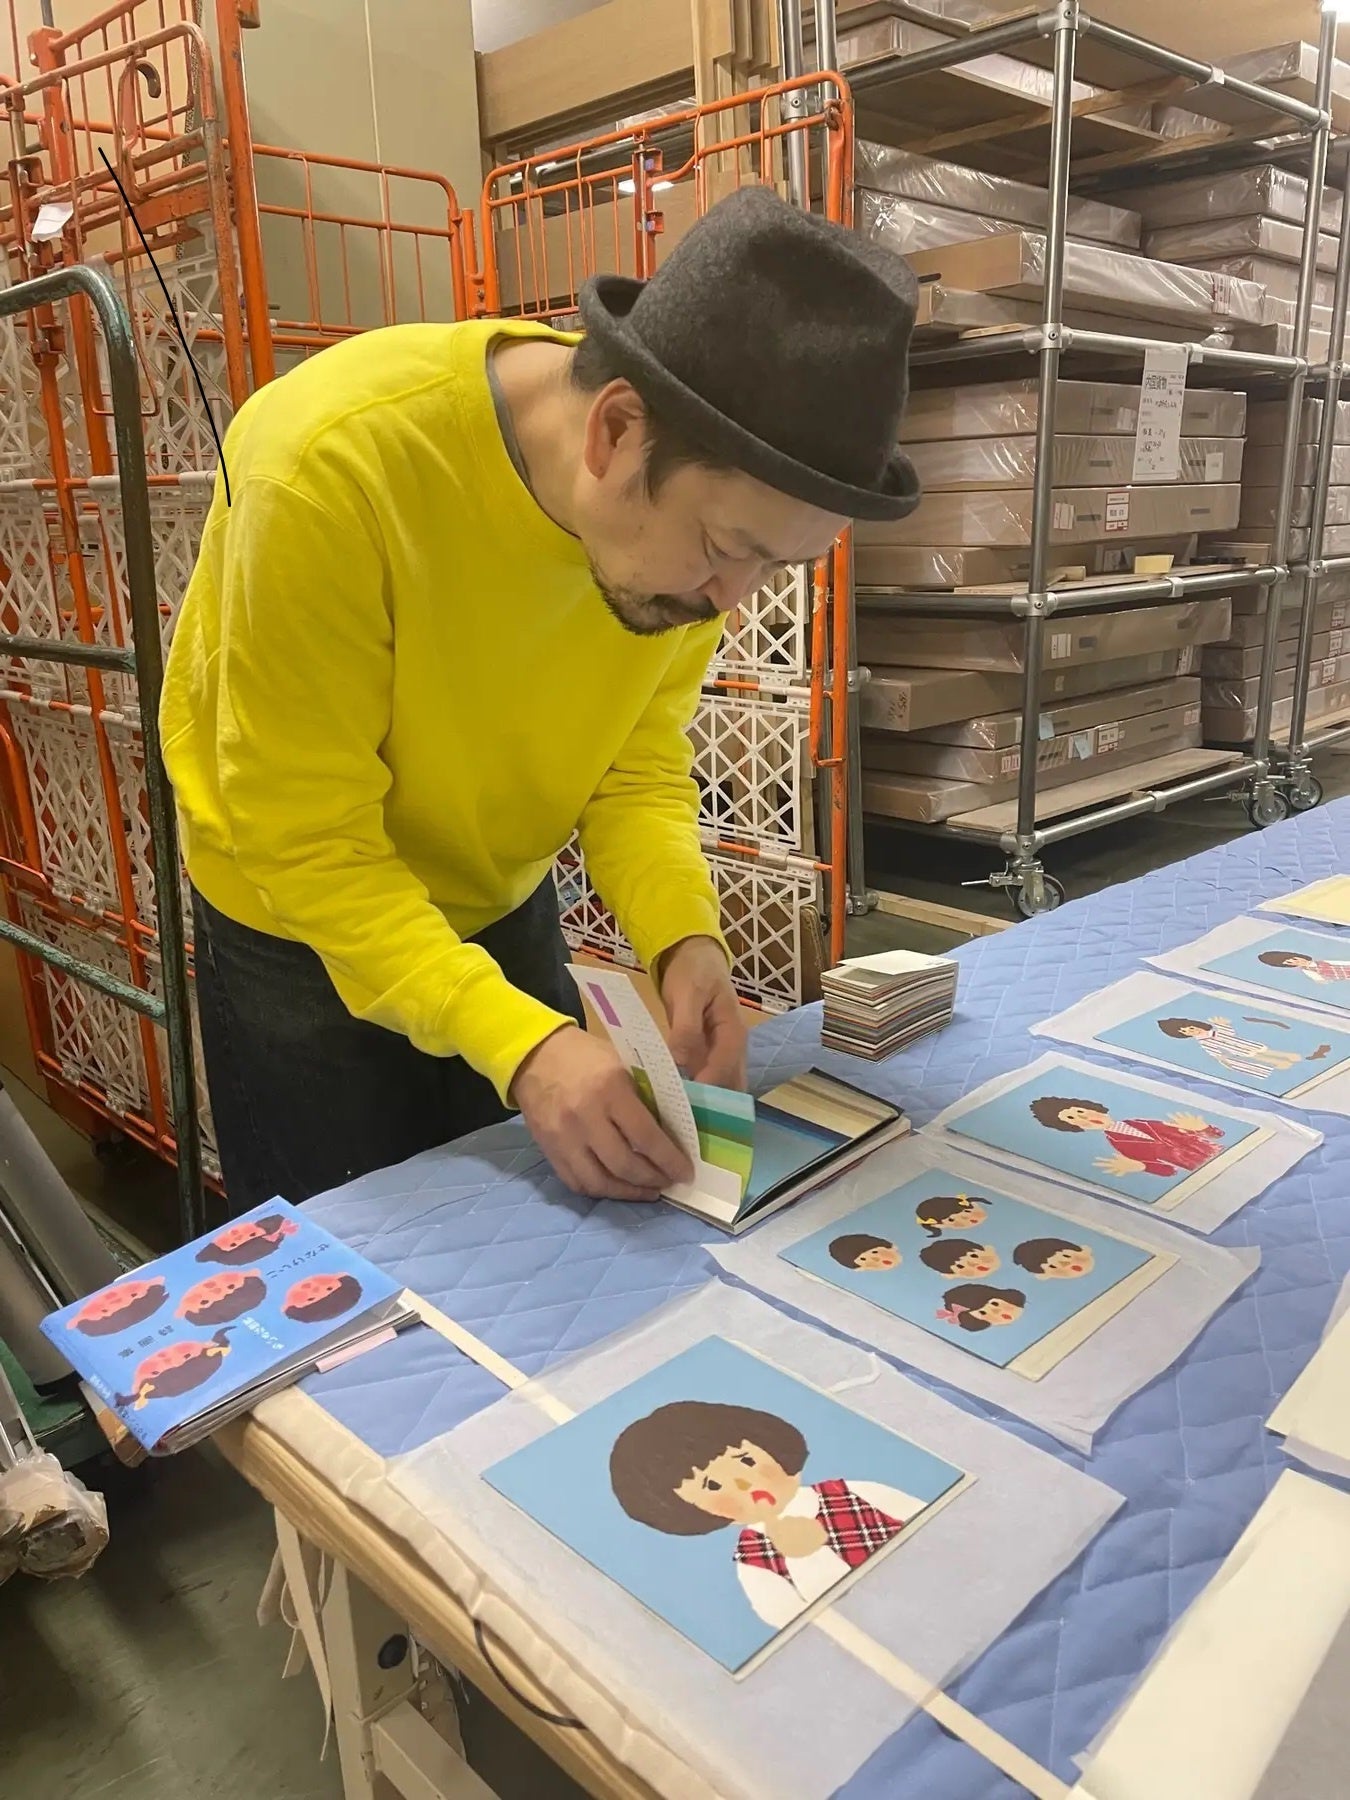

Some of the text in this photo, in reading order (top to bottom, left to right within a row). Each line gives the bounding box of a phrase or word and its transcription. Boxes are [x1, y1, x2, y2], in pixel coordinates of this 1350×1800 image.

[266, 1242, 330, 1280] せなけいこ
